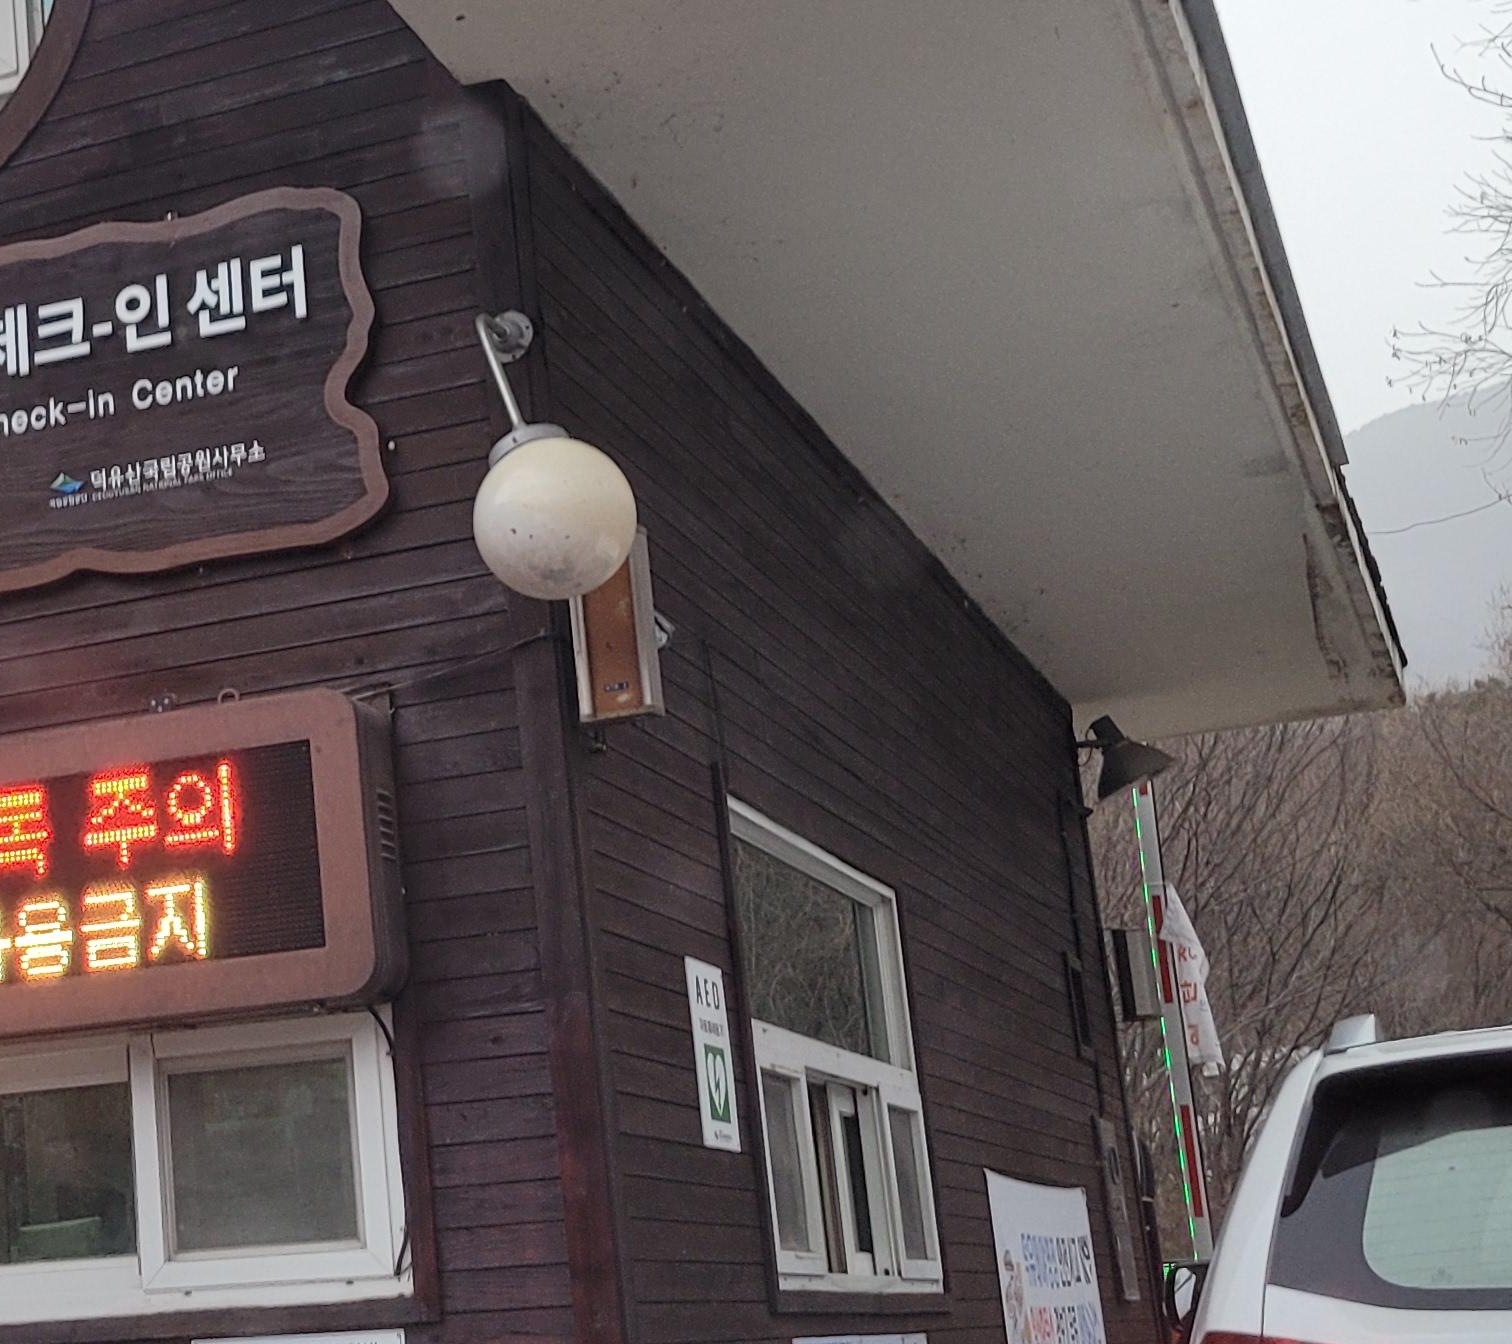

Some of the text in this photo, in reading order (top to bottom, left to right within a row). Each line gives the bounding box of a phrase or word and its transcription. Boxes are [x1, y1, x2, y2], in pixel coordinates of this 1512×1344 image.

[186, 243, 308, 338] 센터
[131, 365, 239, 411] Center
[83, 758, 240, 870] 주의
[695, 975, 721, 1010] AED
